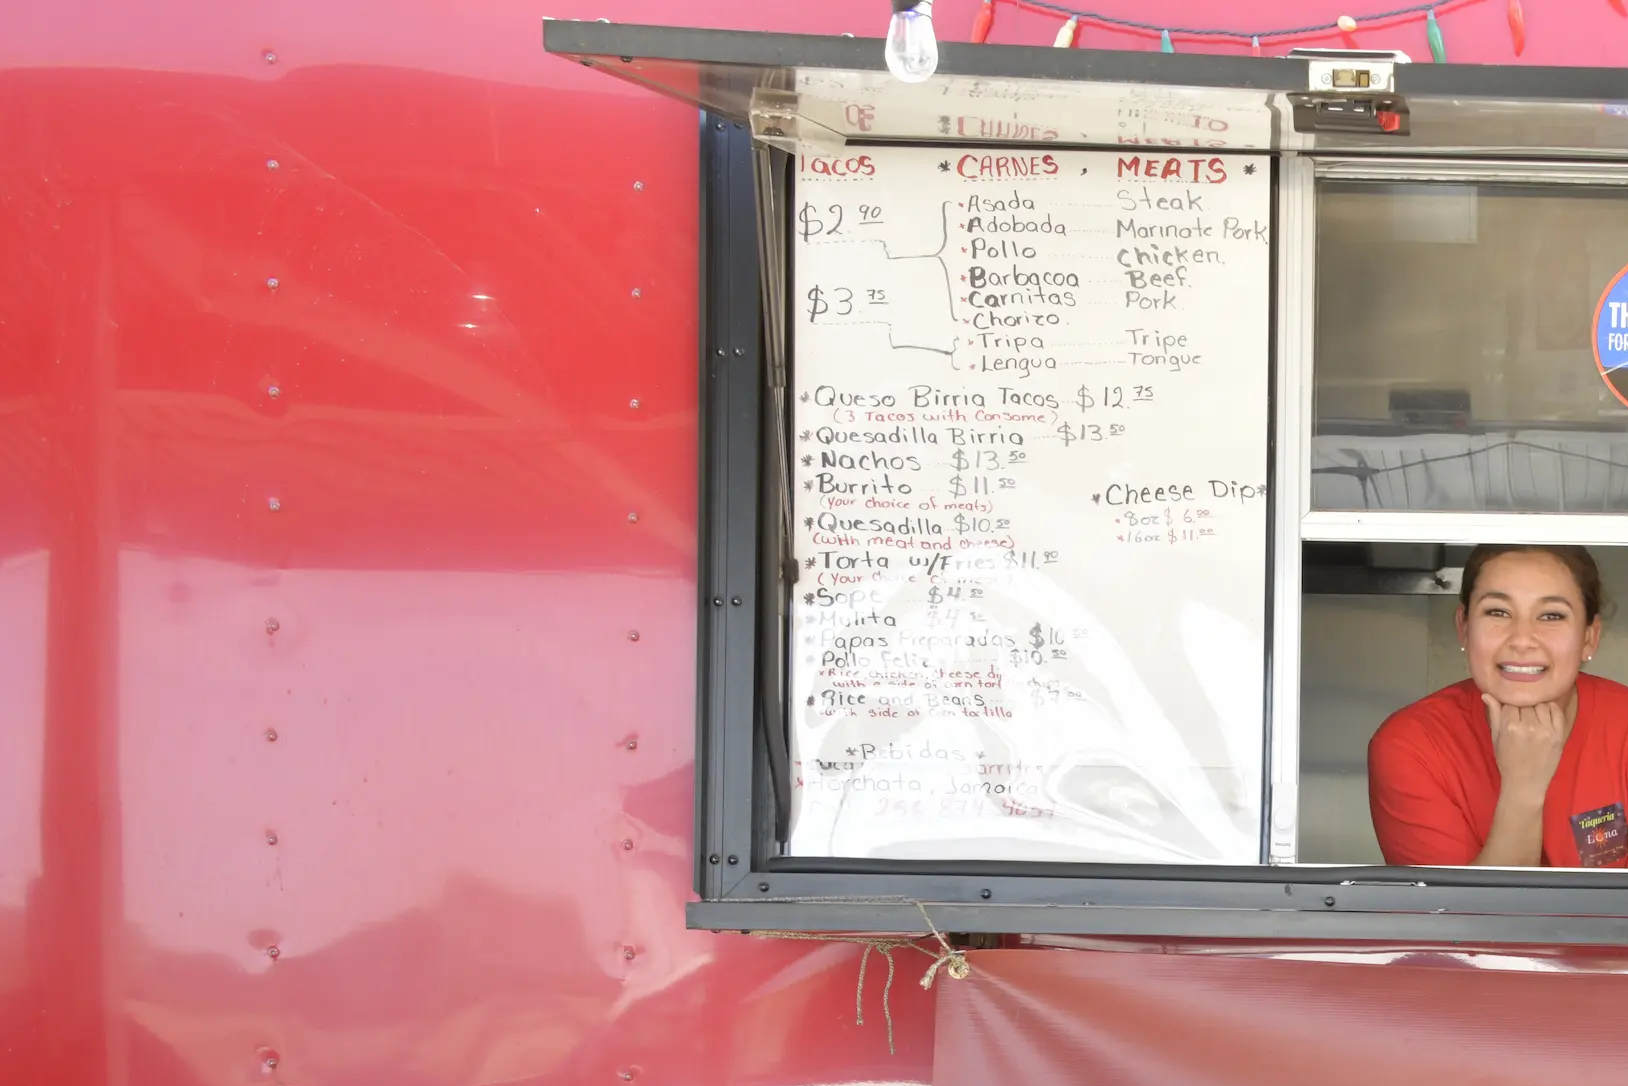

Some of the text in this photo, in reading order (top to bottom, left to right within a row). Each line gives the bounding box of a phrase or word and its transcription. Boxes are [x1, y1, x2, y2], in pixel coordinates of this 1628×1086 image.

[957, 155, 1228, 184] CARNES MEATS
[967, 188, 1203, 212] Asada Steak
[967, 215, 1066, 236] Adobada
[971, 243, 1037, 260] Pollo
[970, 267, 1079, 289] Barbacoa
[968, 290, 1076, 308] Carnitas
[977, 330, 1188, 352] Tripa Tripe
[981, 353, 1201, 383] Lengua Tongue
[814, 385, 896, 409] Queso
[909, 387, 985, 409] Birria
[998, 387, 1059, 409] Tacos
[865, 411, 915, 423] Tacos
[923, 411, 967, 423] with
[817, 427, 938, 446] Quesadilla
[946, 427, 1023, 446] Birria
[821, 450, 922, 471] Nachos
[817, 474, 911, 496] Burrito
[1107, 480, 1256, 505] Cheese Dip
[866, 497, 911, 510] choice
[919, 496, 938, 510] of
[817, 516, 943, 537] Quesadilla
[865, 535, 915, 549] meat
[922, 536, 951, 551] and
[818, 550, 888, 568] Torta
[816, 588, 883, 608] Sope
[820, 630, 888, 649] Papas
[822, 652, 870, 667] Pollo
[1579, 812, 1615, 829] Taqueria
